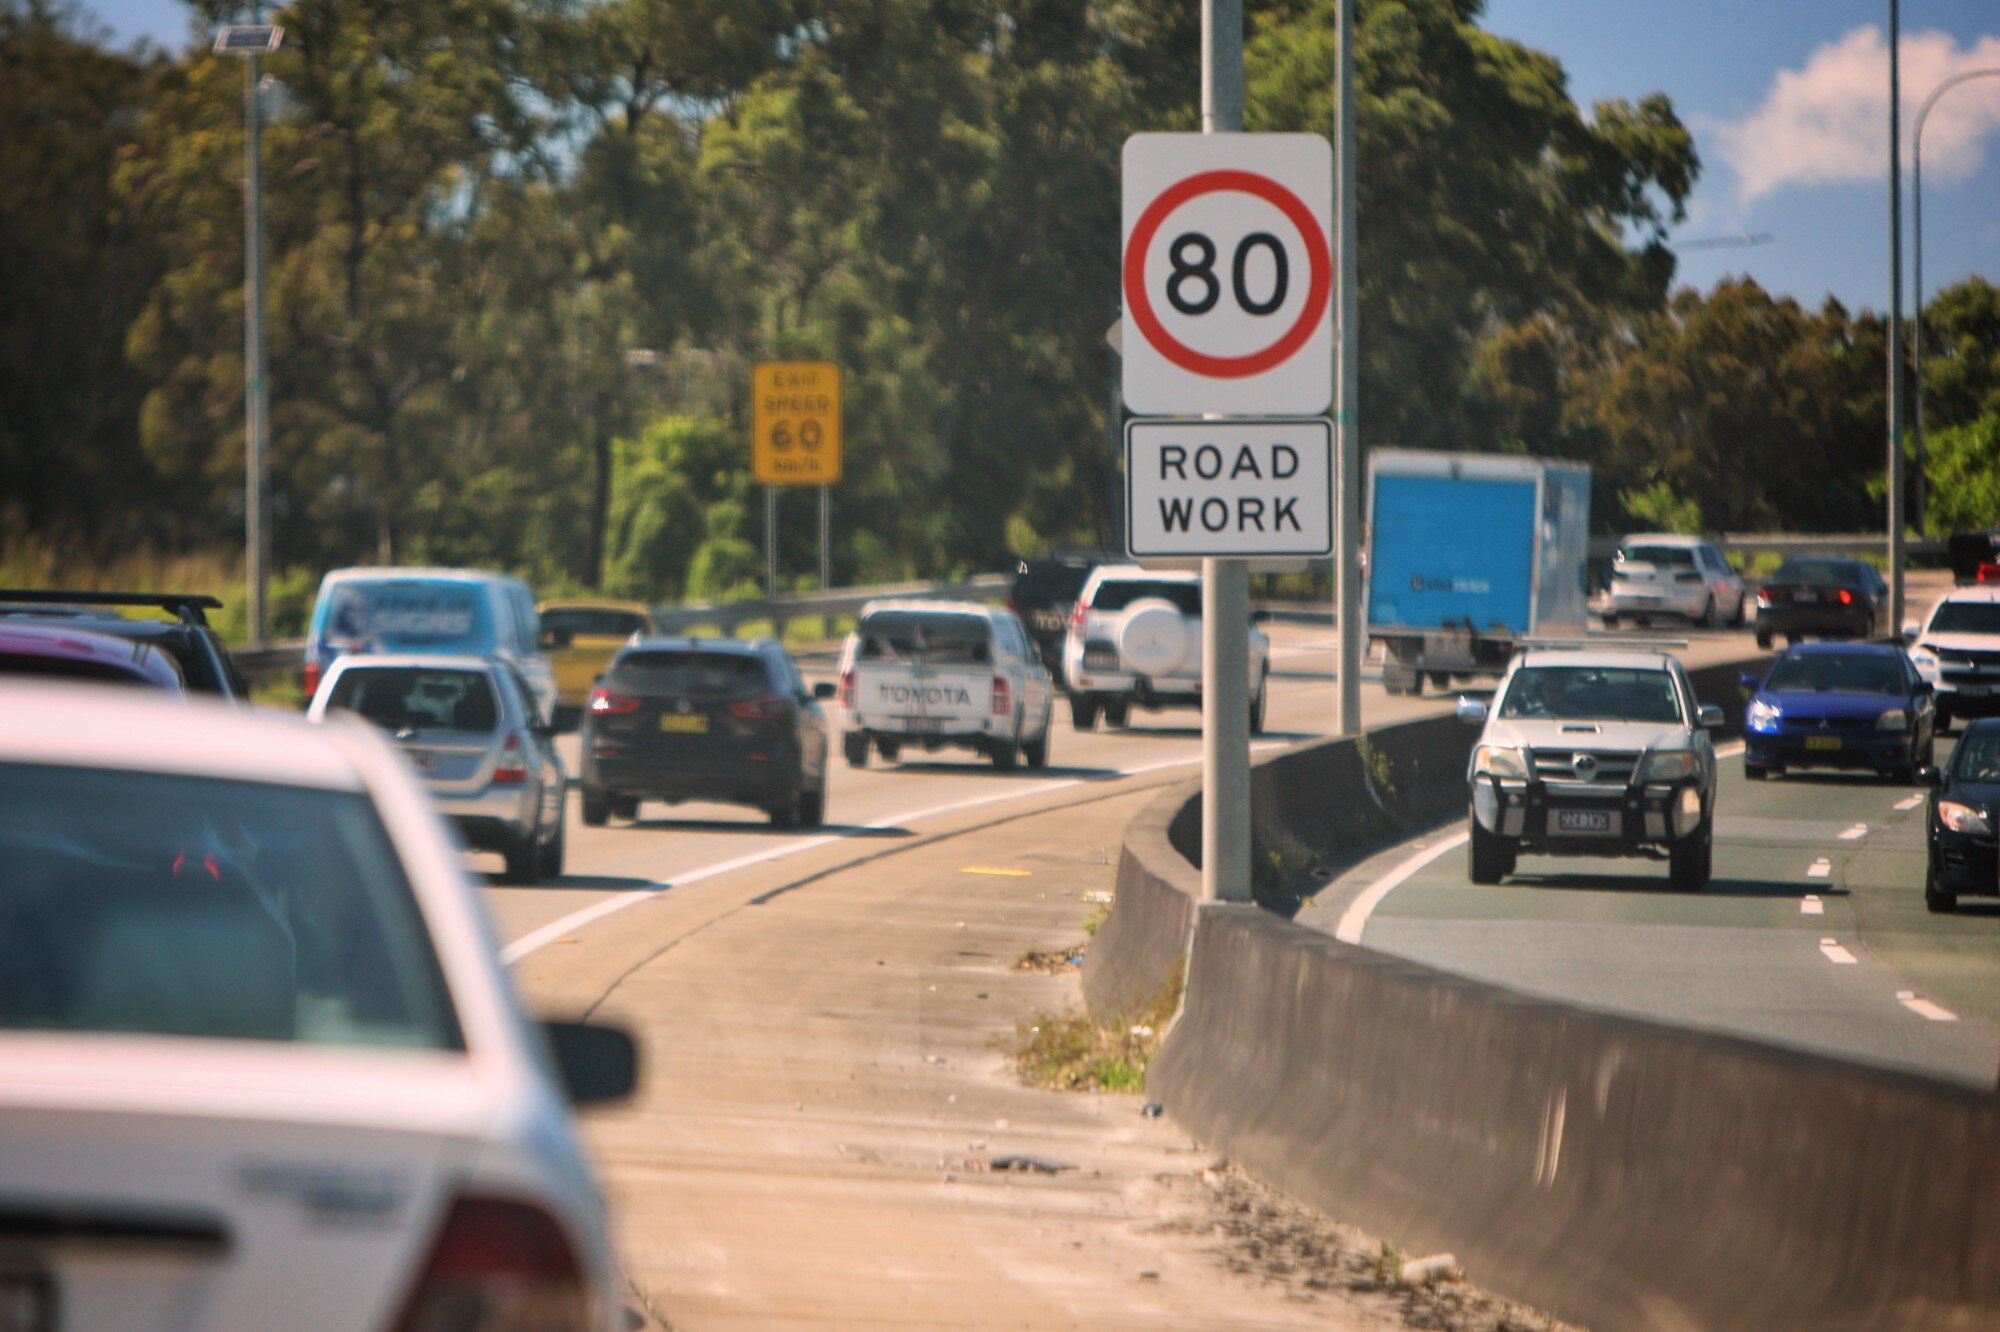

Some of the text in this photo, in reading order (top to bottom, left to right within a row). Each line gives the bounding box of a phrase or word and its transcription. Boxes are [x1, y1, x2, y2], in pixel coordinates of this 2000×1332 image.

[1165, 230, 1290, 317] 80
[773, 370, 818, 387] EXIT
[764, 394, 830, 413] SPEED
[771, 419, 822, 453] 60
[1159, 444, 1300, 480] ROAD
[1158, 496, 1303, 533] WORK
[879, 684, 972, 706] TOYOTA
